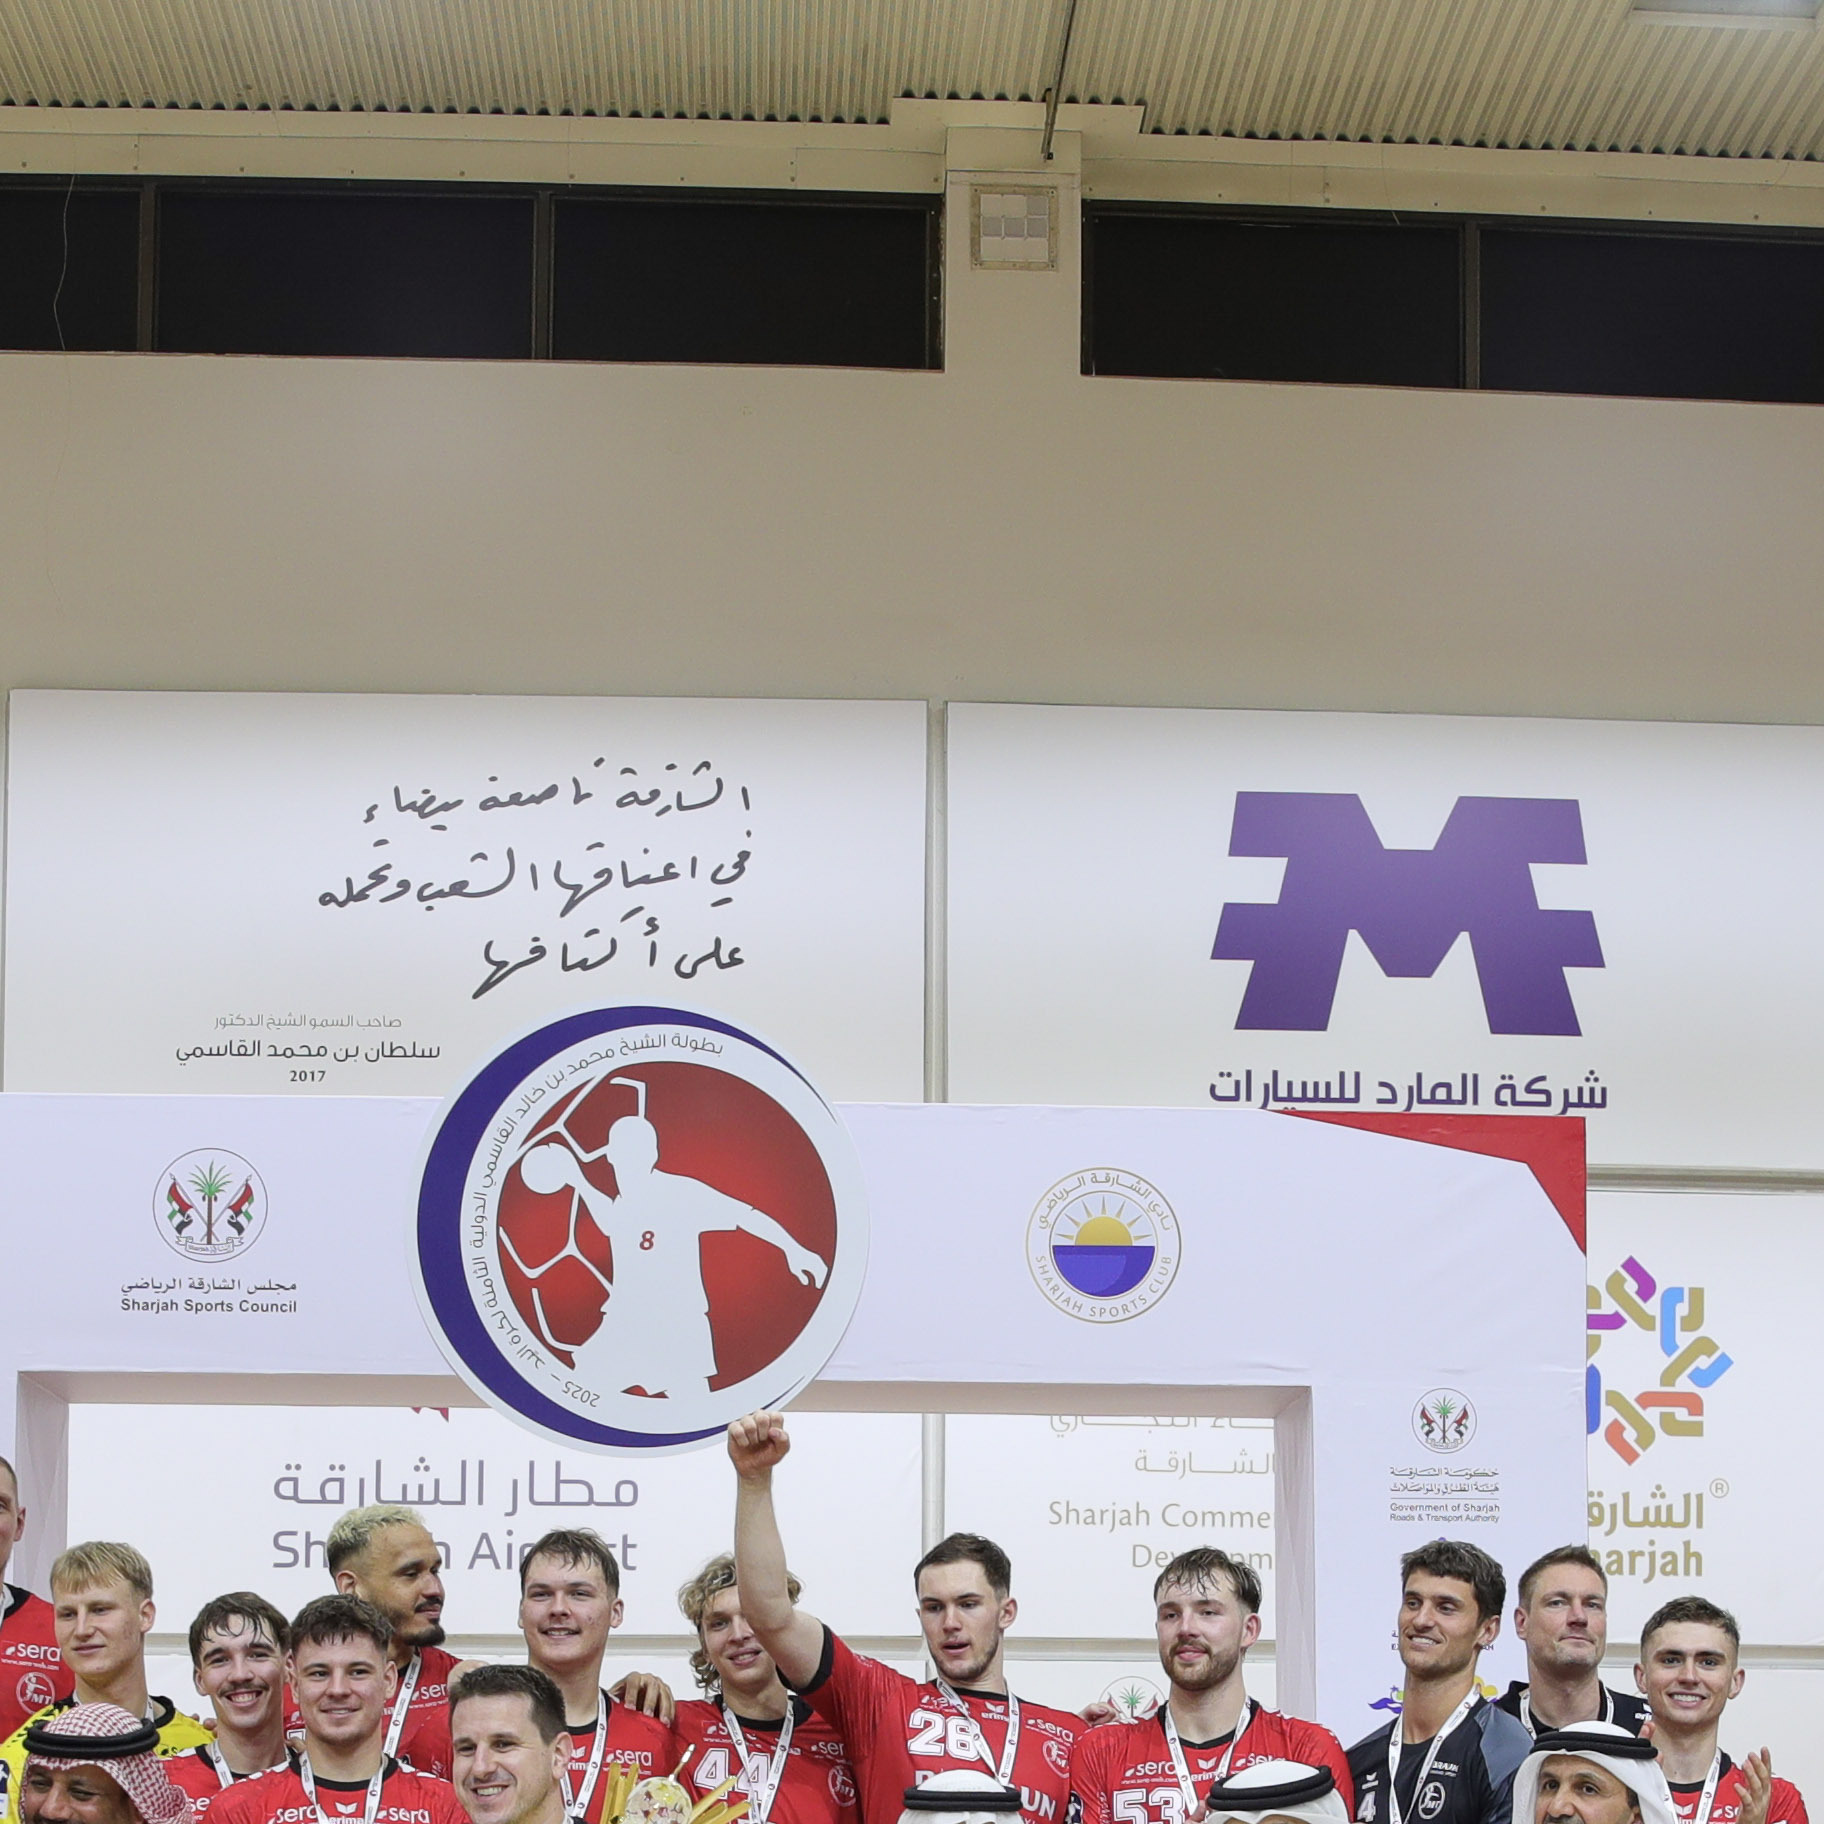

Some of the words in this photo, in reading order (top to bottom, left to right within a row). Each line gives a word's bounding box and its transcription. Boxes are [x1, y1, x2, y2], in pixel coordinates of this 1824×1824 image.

[213, 1014, 264, 1030] الدكتور
[266, 1012, 306, 1030] الشيخ
[311, 1015, 353, 1030] السمو
[357, 1015, 403, 1030] صاحب
[175, 1039, 261, 1066] القاسمي
[266, 1044, 327, 1058] محمد
[333, 1044, 360, 1062] بن
[364, 1041, 441, 1062] سلطان
[619, 1033, 666, 1057] الشيخ
[671, 1031, 724, 1058] بطولة
[567, 1048, 615, 1074] محمد
[289, 1070, 326, 1082] 2017
[545, 1069, 567, 1090] بن
[515, 1085, 547, 1119] خالد
[1209, 1069, 1361, 1111] للسيارات
[1375, 1071, 1479, 1113] المارد
[1494, 1069, 1608, 1116] شركة
[483, 1115, 520, 1189] القاسمي
[639, 1230, 655, 1251] 8
[121, 1277, 182, 1296] الرياضي
[188, 1277, 241, 1294] الشارقة
[246, 1280, 297, 1295] مجلس
[1035, 1255, 1085, 1314] SHARJAH
[1089, 1294, 1148, 1318] SPORTS
[1148, 1256, 1172, 1294] CLUB
[121, 1299, 179, 1314] Sharjah
[183, 1299, 234, 1314] Sports
[239, 1300, 297, 1313] Council
[561, 1380, 601, 1407] 2025
[273, 1456, 484, 1508] الشارقة
[504, 1459, 639, 1517] مطار
[1048, 1500, 1151, 1533] Sharjah
[1161, 1503, 1271, 1529] Comme
[1390, 1502, 1448, 1512] Government
[1451, 1502, 1461, 1512] of
[1463, 1503, 1501, 1514] Sharjah
[1588, 1484, 1704, 1536] الشارق
[1590, 1540, 1703, 1584] arjah
[16, 1642, 62, 1662] sera
[1036, 1718, 1074, 1743] sera
[693, 1747, 771, 1805] 44
[388, 1804, 431, 1824] sera
